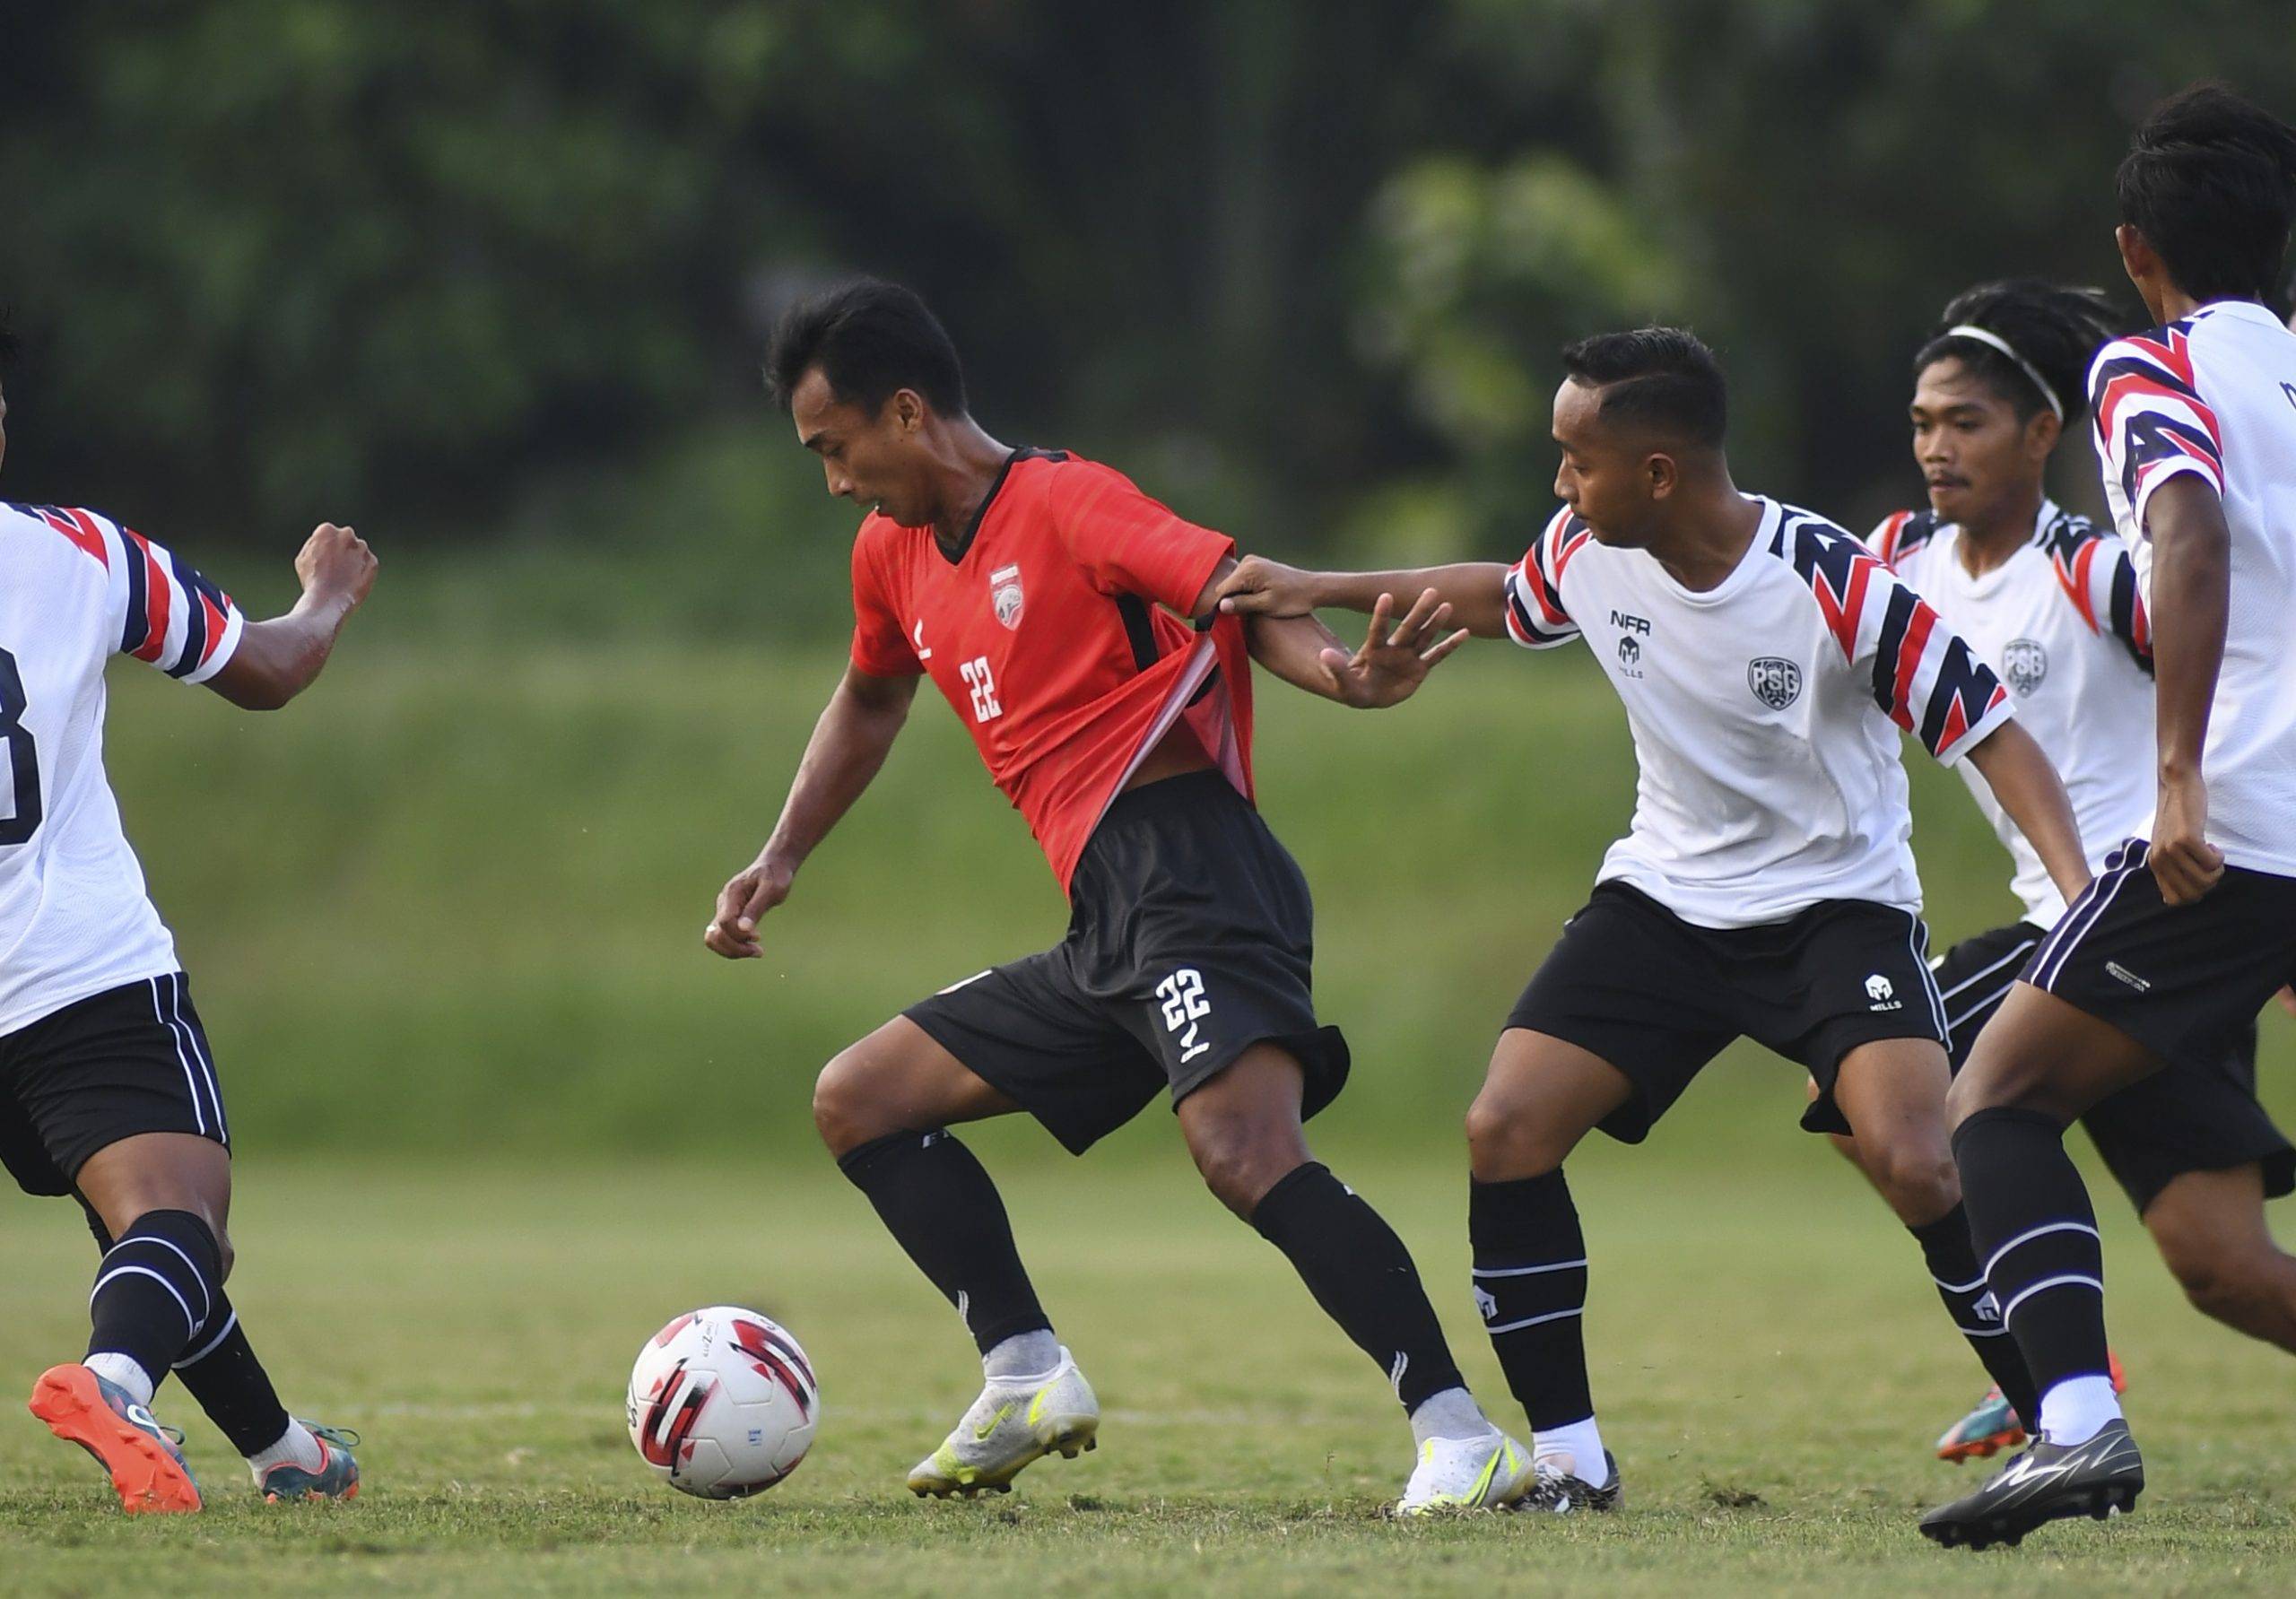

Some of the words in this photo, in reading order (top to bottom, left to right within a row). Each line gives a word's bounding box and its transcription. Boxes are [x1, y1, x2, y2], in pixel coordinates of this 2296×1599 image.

[1610, 610, 1650, 636] NFR
[1618, 665, 1643, 679] LLS
[1752, 667, 1799, 691] PSG
[960, 656, 1003, 723] 22
[1155, 969, 1211, 1032] 22
